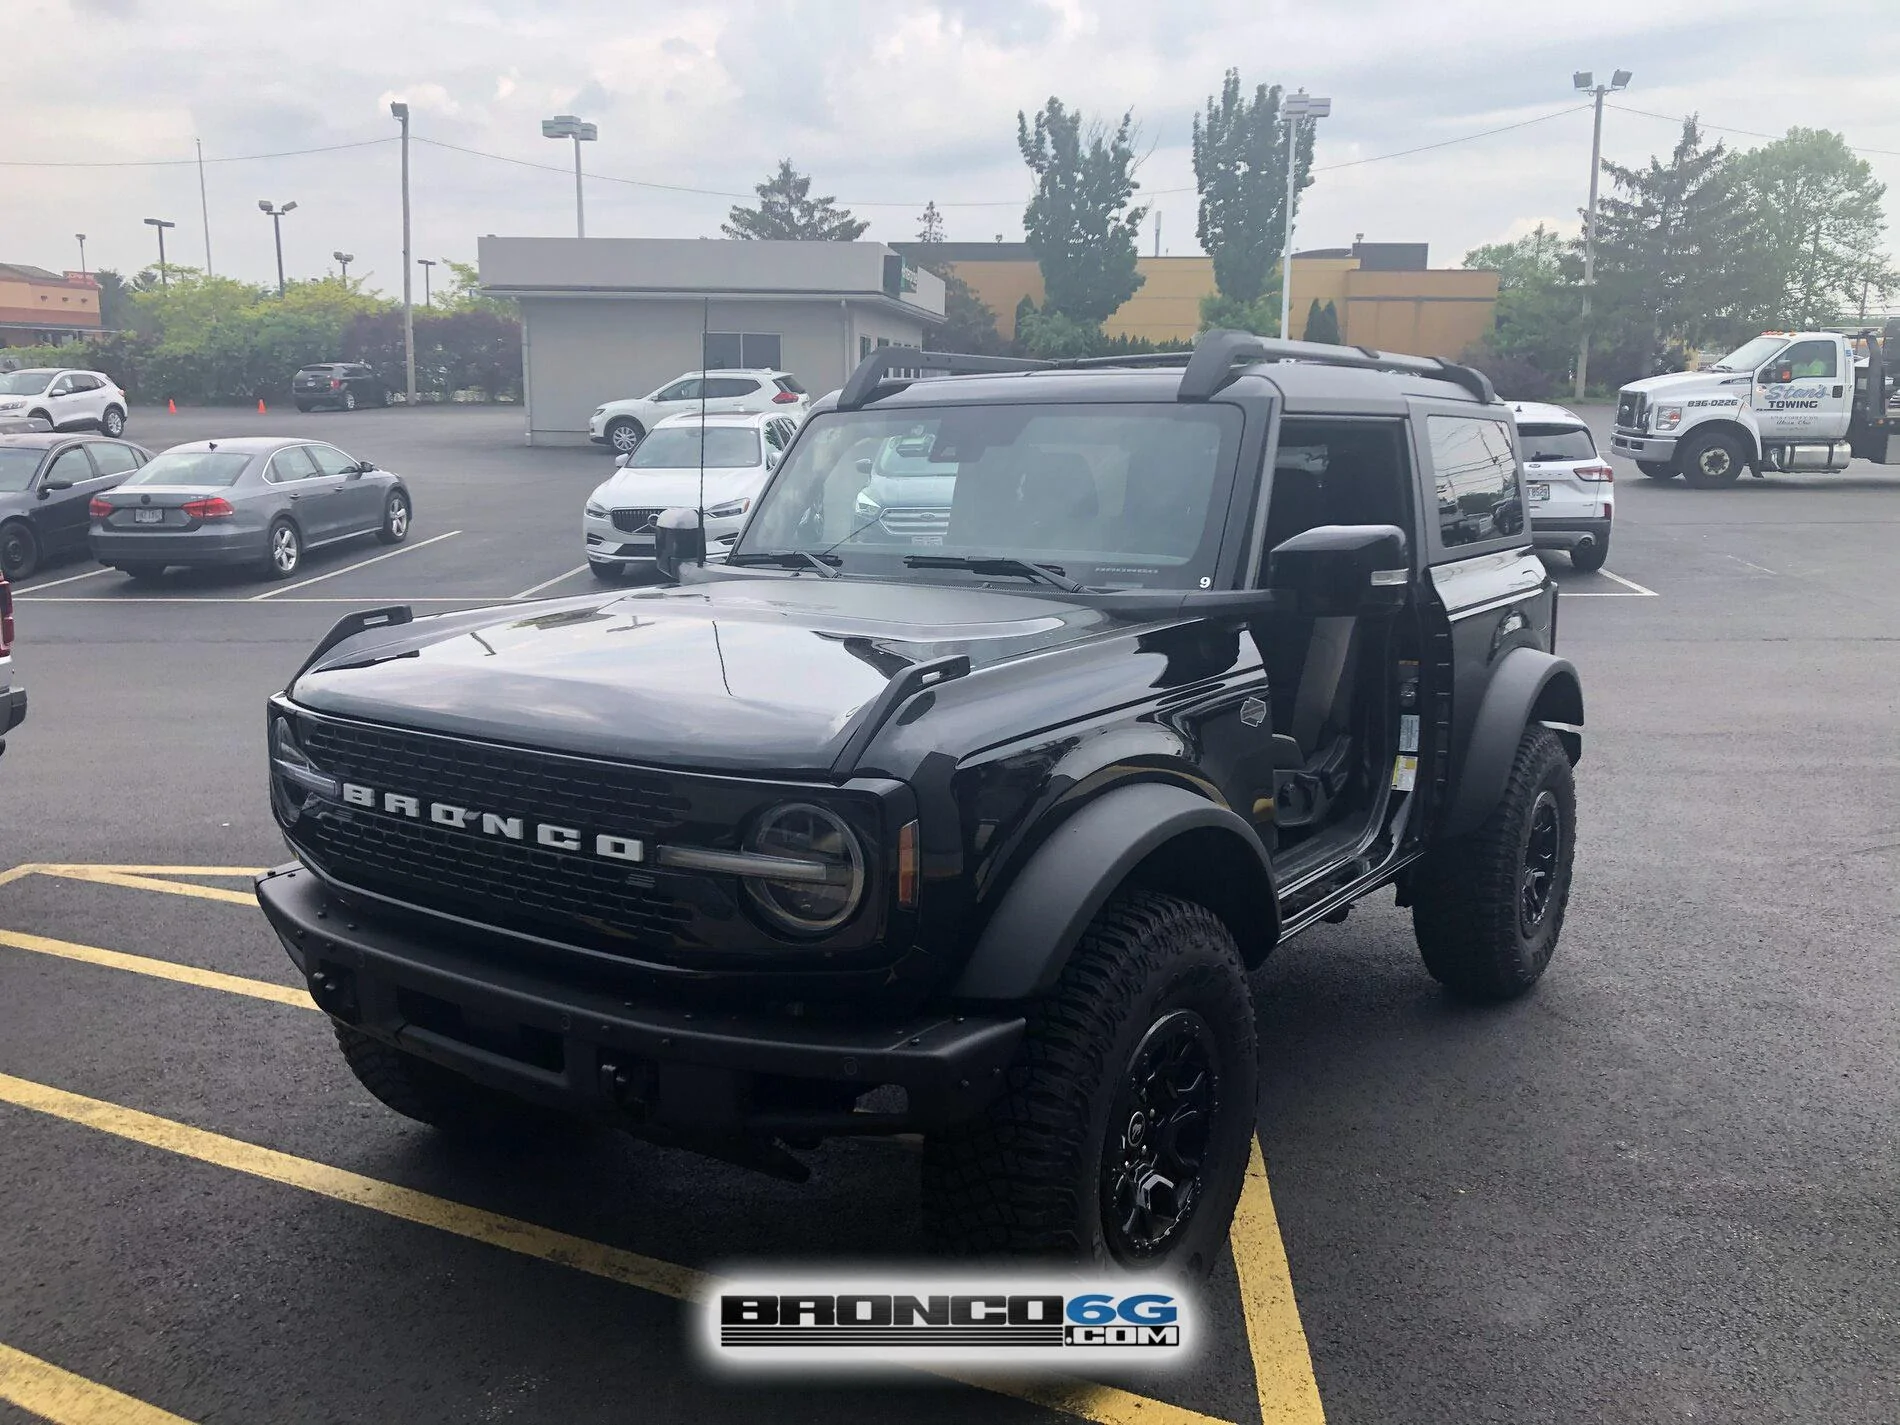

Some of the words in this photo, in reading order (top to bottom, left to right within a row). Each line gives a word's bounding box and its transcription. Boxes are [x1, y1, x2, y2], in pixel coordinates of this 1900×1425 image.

[1765, 384, 1829, 400] Stan's
[1768, 400, 1818, 409] TOWING
[1199, 576, 1211, 589] 9
[343, 782, 644, 862] BRONCO
